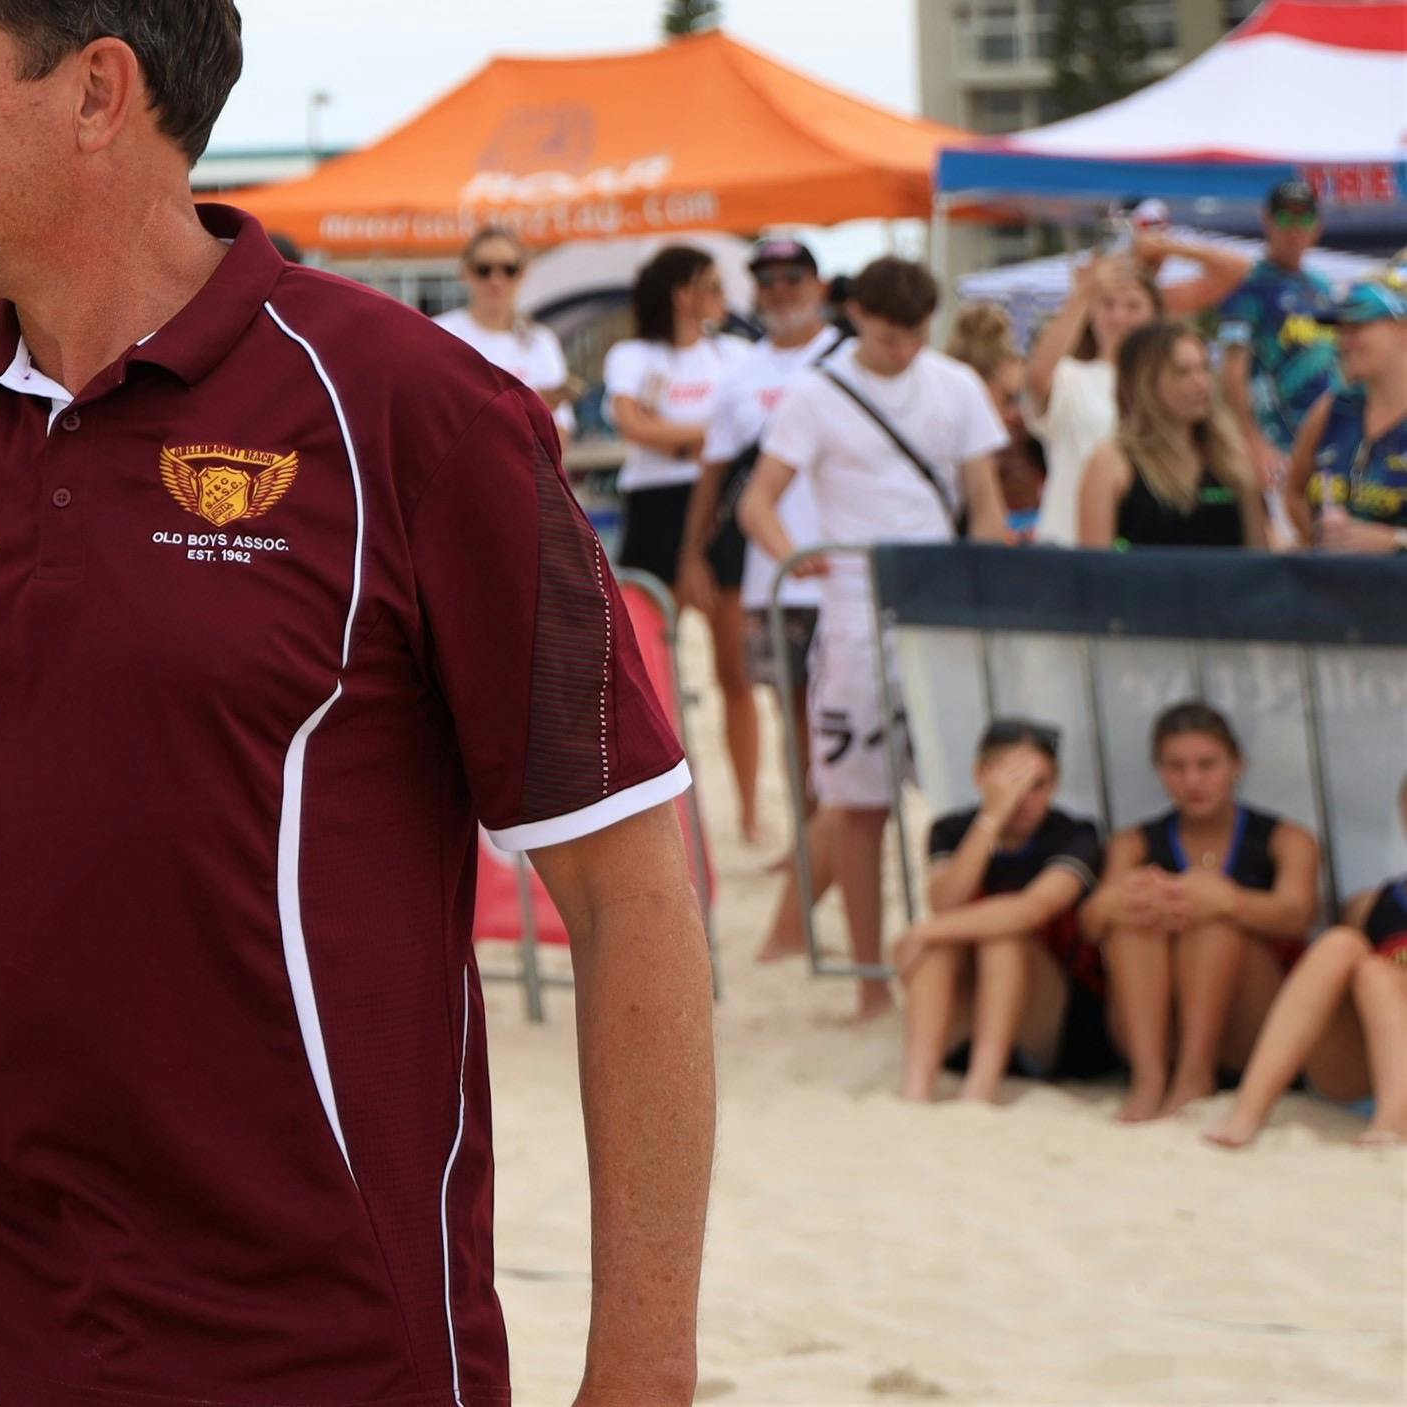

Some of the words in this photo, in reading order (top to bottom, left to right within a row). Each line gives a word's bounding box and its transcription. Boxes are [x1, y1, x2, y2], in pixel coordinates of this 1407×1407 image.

[152, 531, 183, 544] OLD
[187, 533, 228, 547] BOYS
[232, 534, 290, 552] ASSOC.
[187, 549, 217, 562] EST.
[221, 549, 251, 564] 1962
